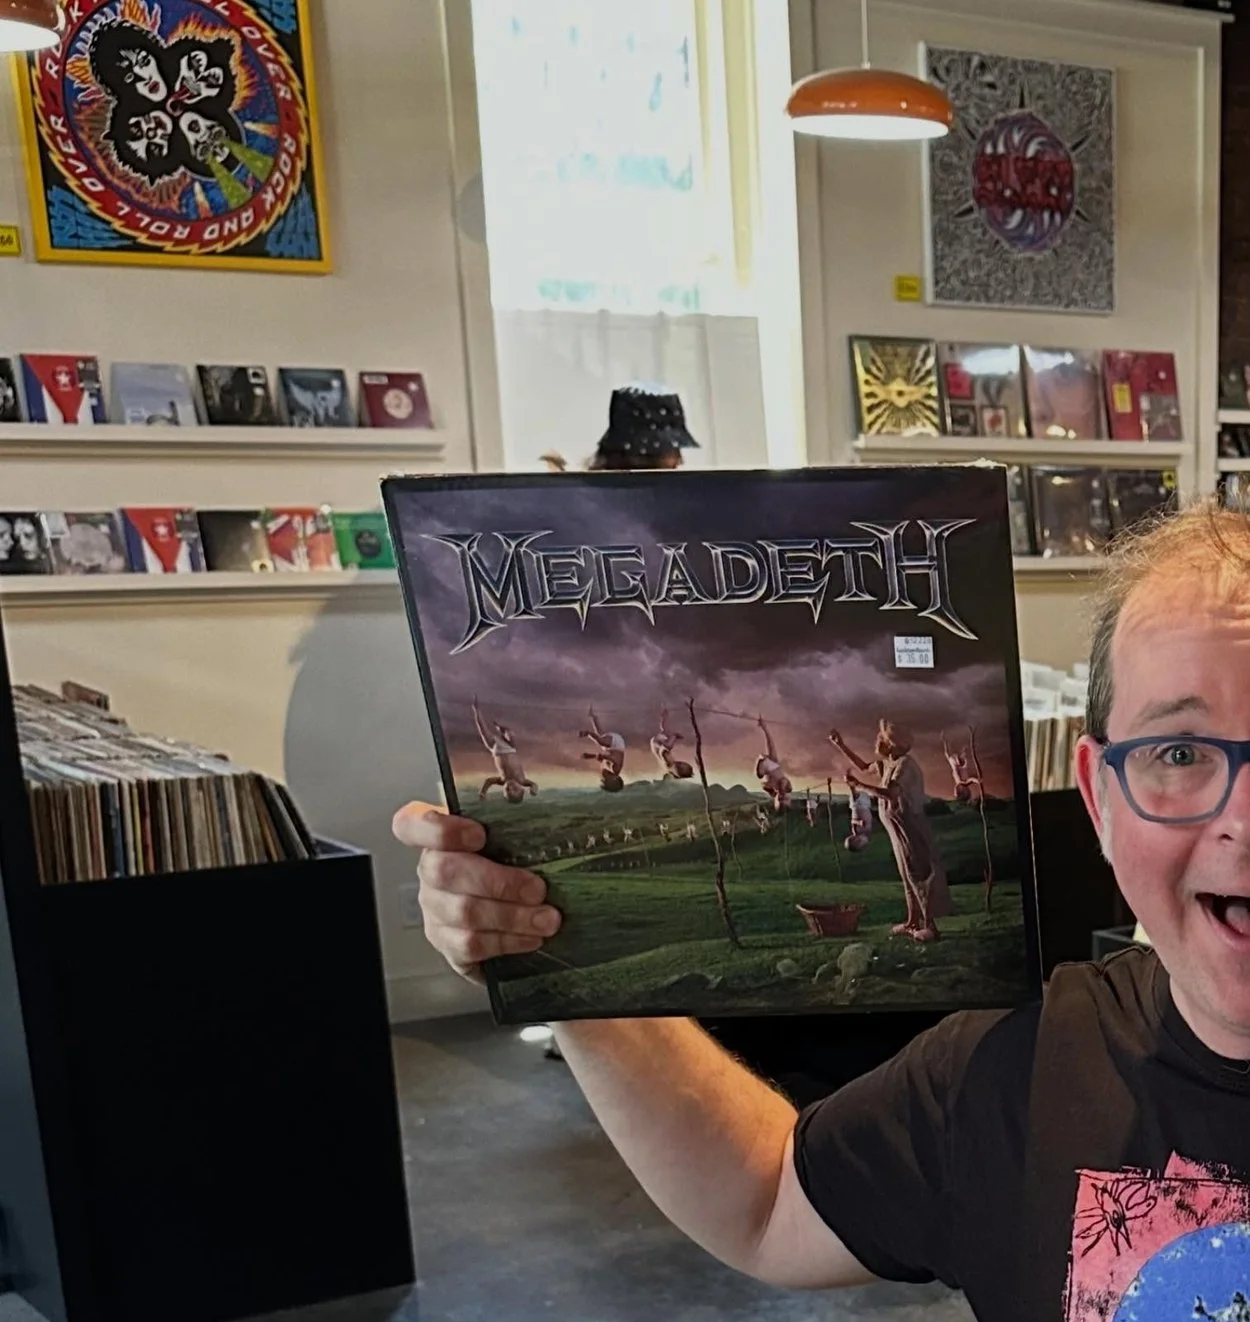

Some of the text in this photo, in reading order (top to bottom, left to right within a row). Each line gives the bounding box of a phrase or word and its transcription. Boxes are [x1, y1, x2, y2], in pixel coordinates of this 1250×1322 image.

[241, 26, 293, 101] OVER
[50, 114, 105, 192] OVER
[262, 132, 297, 211] ROCK
[116, 201, 190, 239] ROLL
[203, 208, 255, 240] AND
[421, 518, 979, 655] MEGADETH
